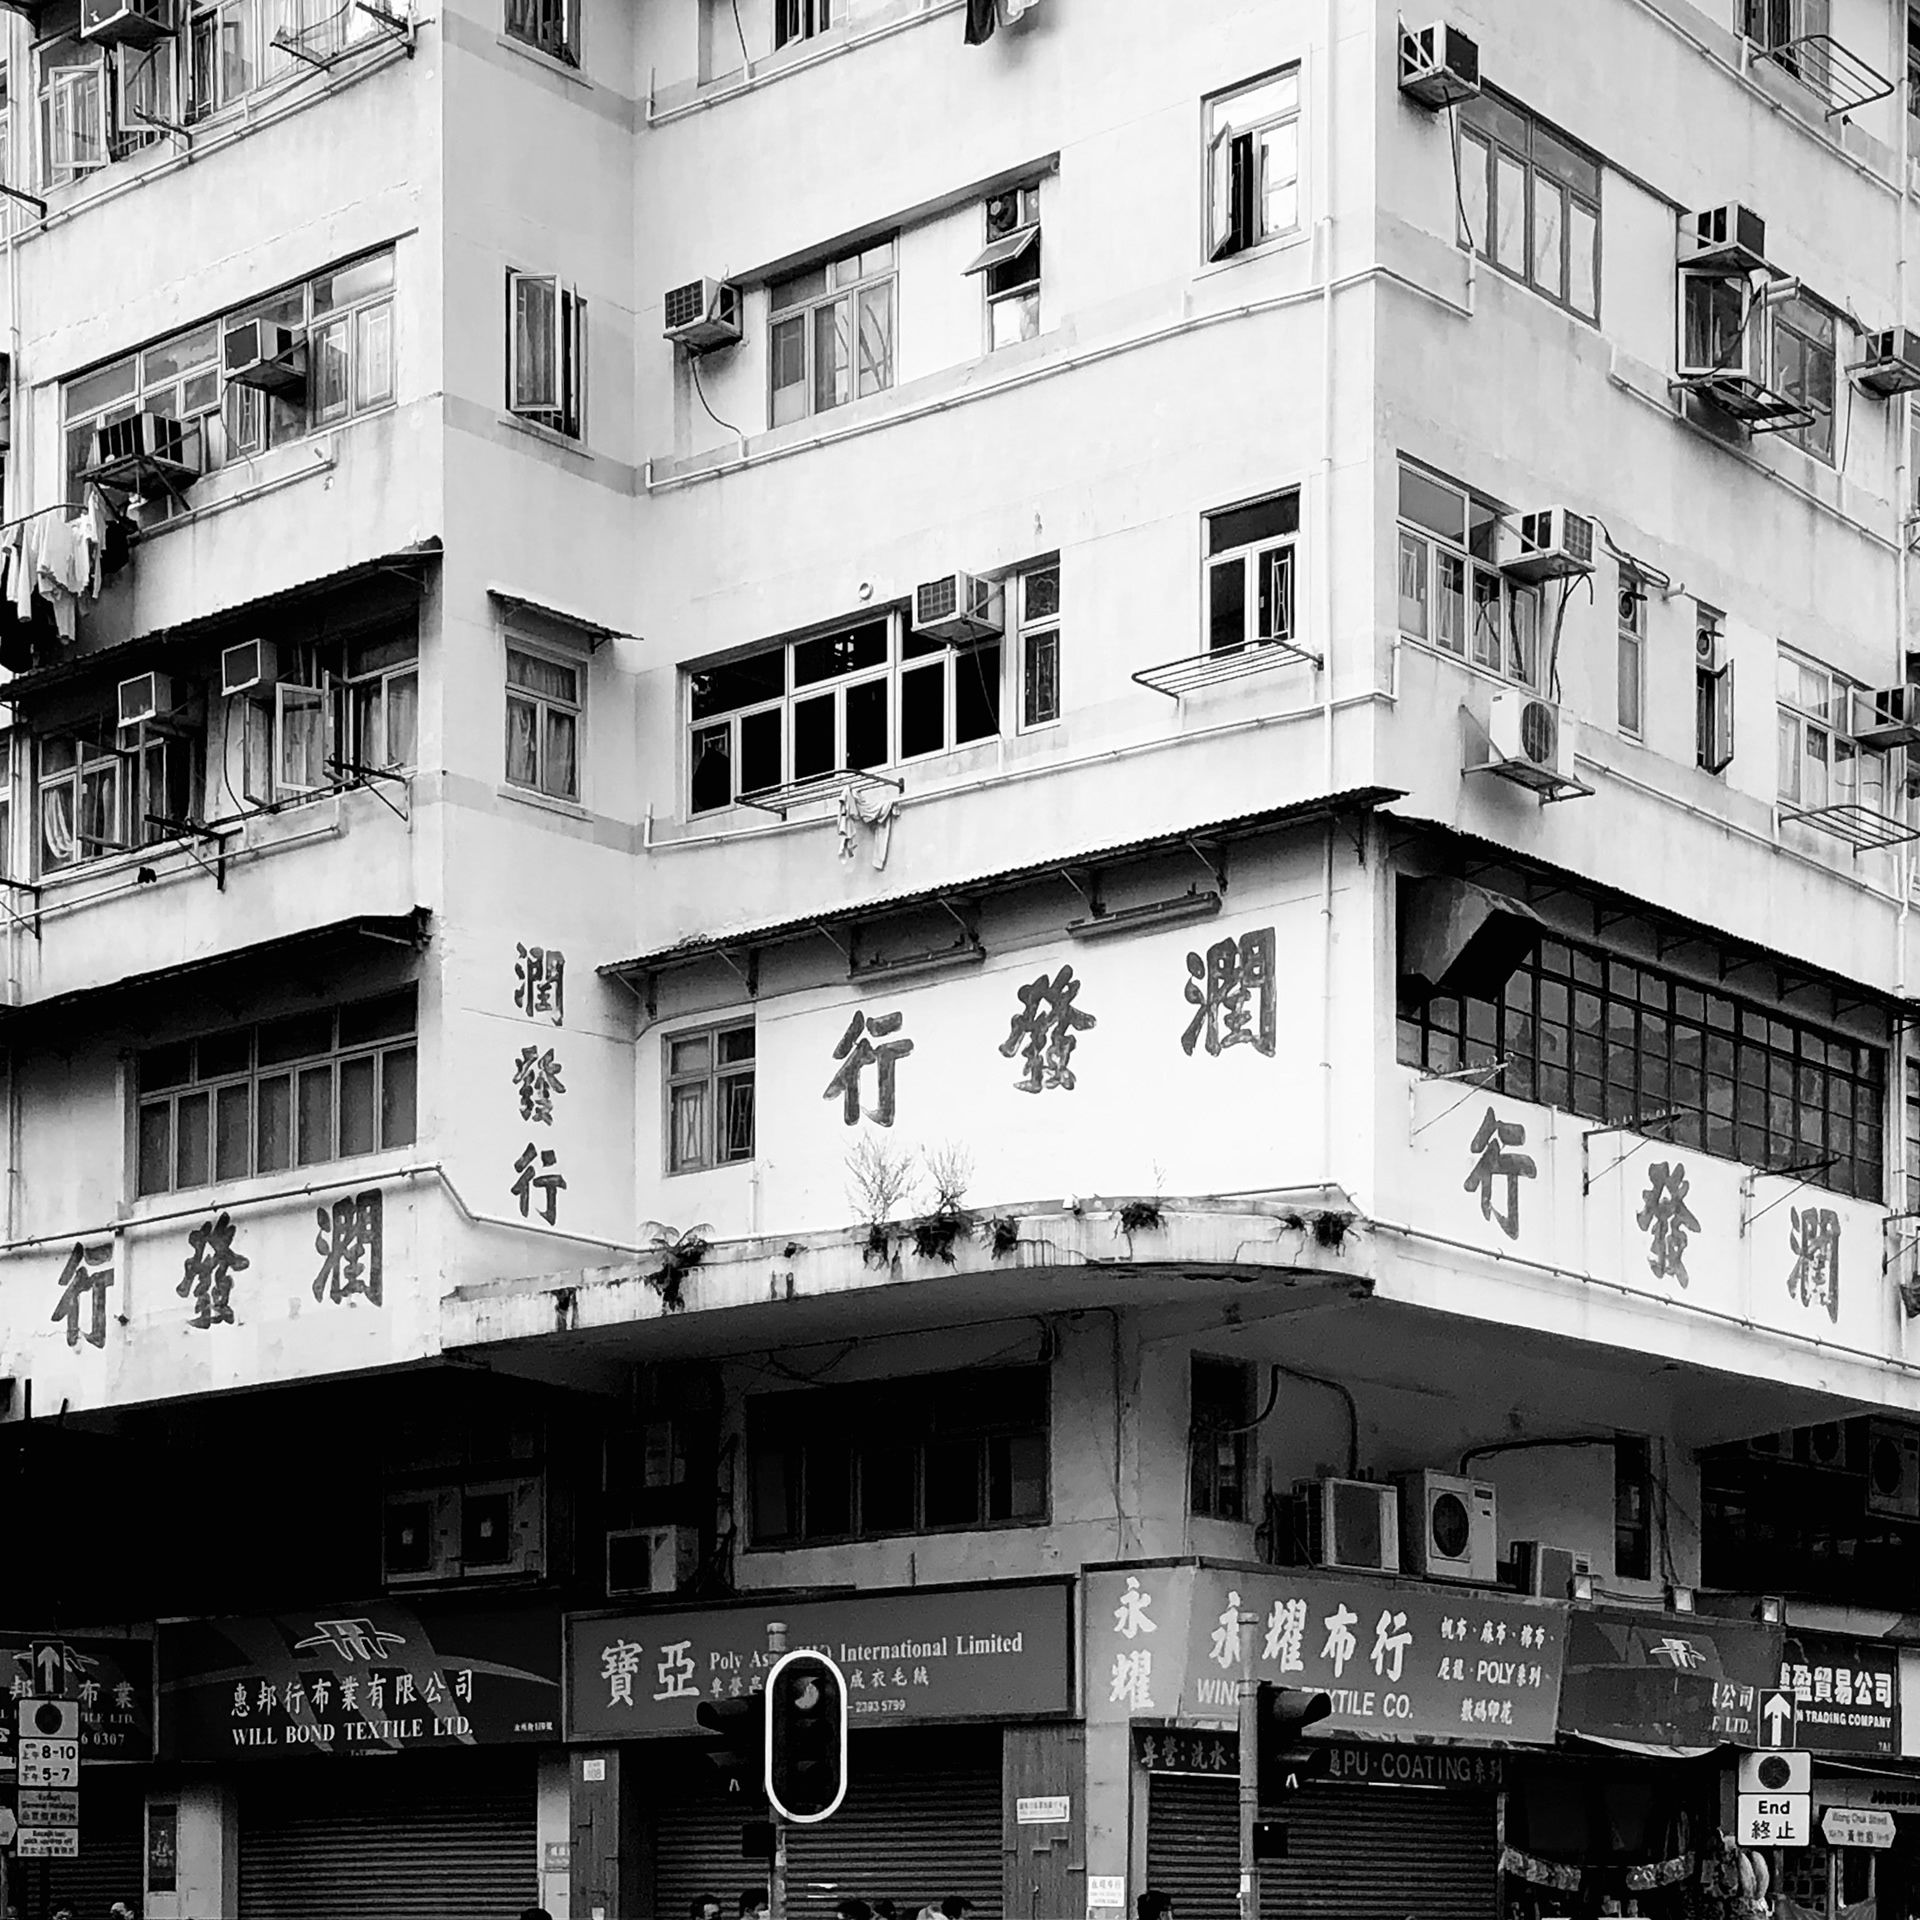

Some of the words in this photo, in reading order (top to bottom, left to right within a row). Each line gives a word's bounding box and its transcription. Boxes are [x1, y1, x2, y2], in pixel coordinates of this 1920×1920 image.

[709, 1651, 743, 1674] Poly
[840, 1637, 947, 1663] International
[955, 1632, 1023, 1656] Limited
[1109, 1576, 1157, 1711] 永耀
[231, 1669, 473, 1717] 惠邦行布業有限公司
[1383, 1693, 1413, 1719] CO.
[232, 1727, 278, 1746] WILL
[286, 1724, 335, 1743] BOND
[343, 1719, 423, 1741] TEXTILE
[433, 1716, 474, 1737] LTD.
[1805, 1710, 1846, 1726] TRADING
[1848, 1712, 1892, 1729] COMPANY
[42, 1745, 76, 1760] 8-10
[42, 1767, 70, 1781] 5-7
[1758, 1800, 1790, 1815] End
[1751, 1820, 1796, 1840] 終止
